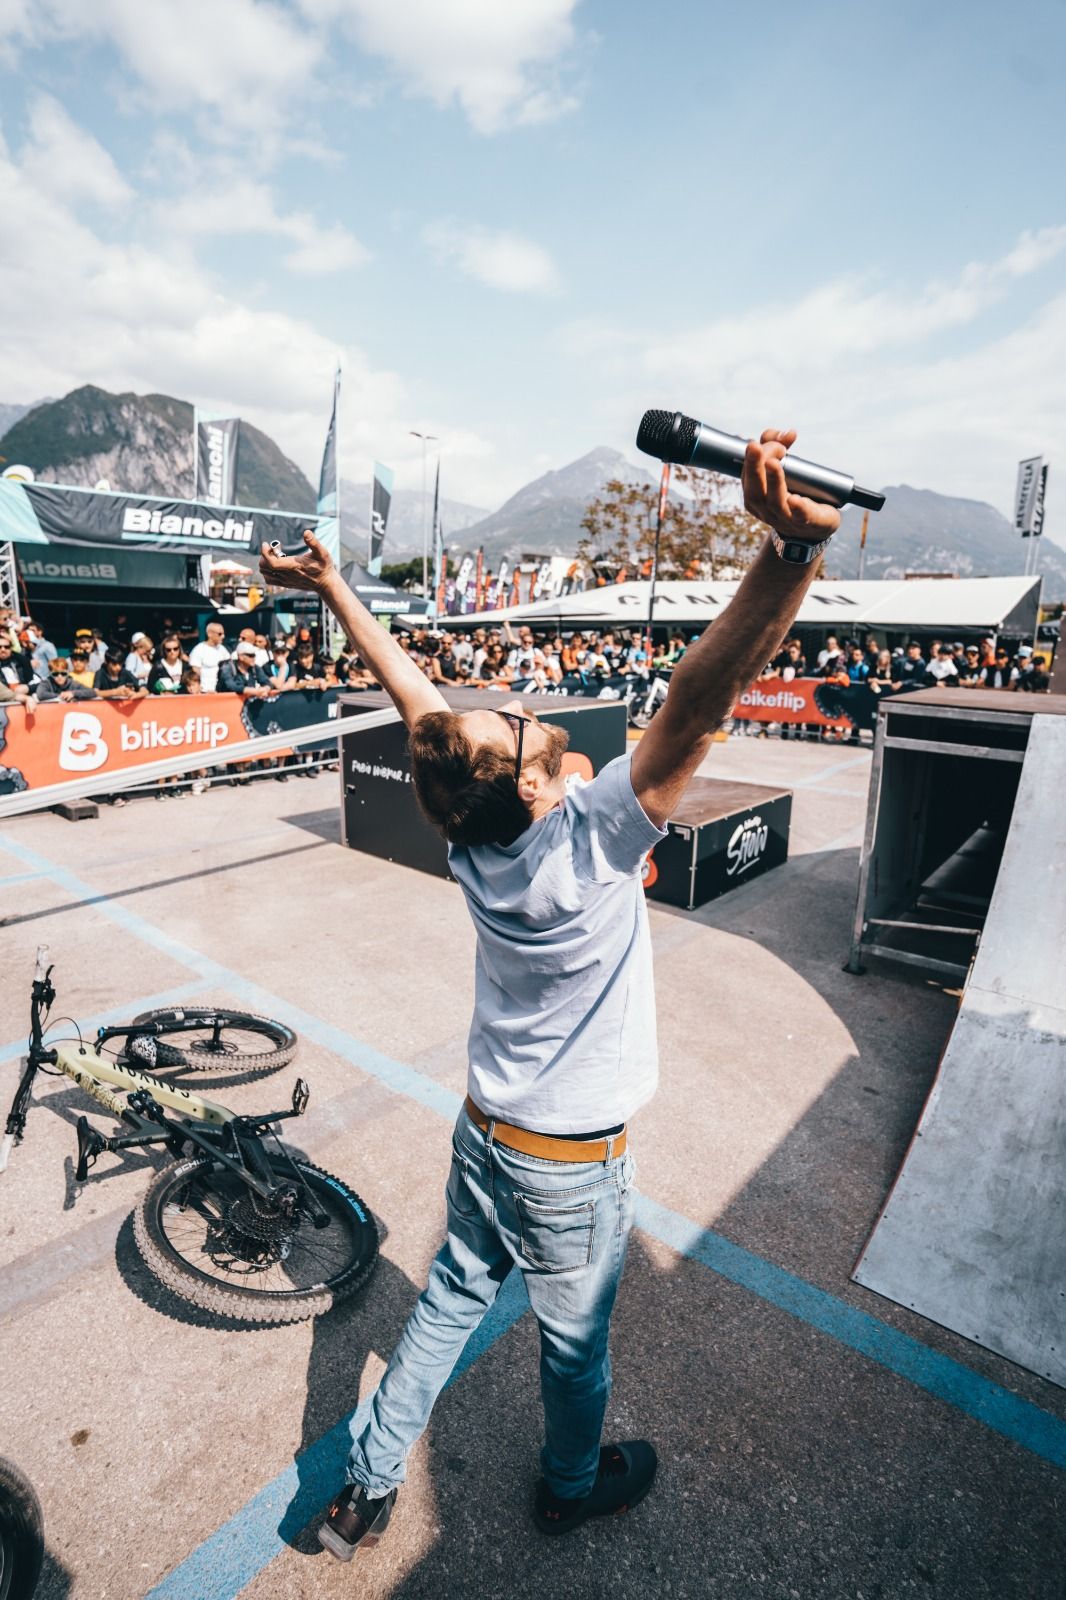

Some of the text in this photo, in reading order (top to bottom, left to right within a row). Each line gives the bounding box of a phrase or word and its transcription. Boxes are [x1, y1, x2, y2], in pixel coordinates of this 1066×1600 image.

[207, 425, 224, 505] ianchi
[122, 507, 254, 542] Bianchi
[618, 594, 858, 606] CANN
[121, 716, 229, 752] bikeflip
